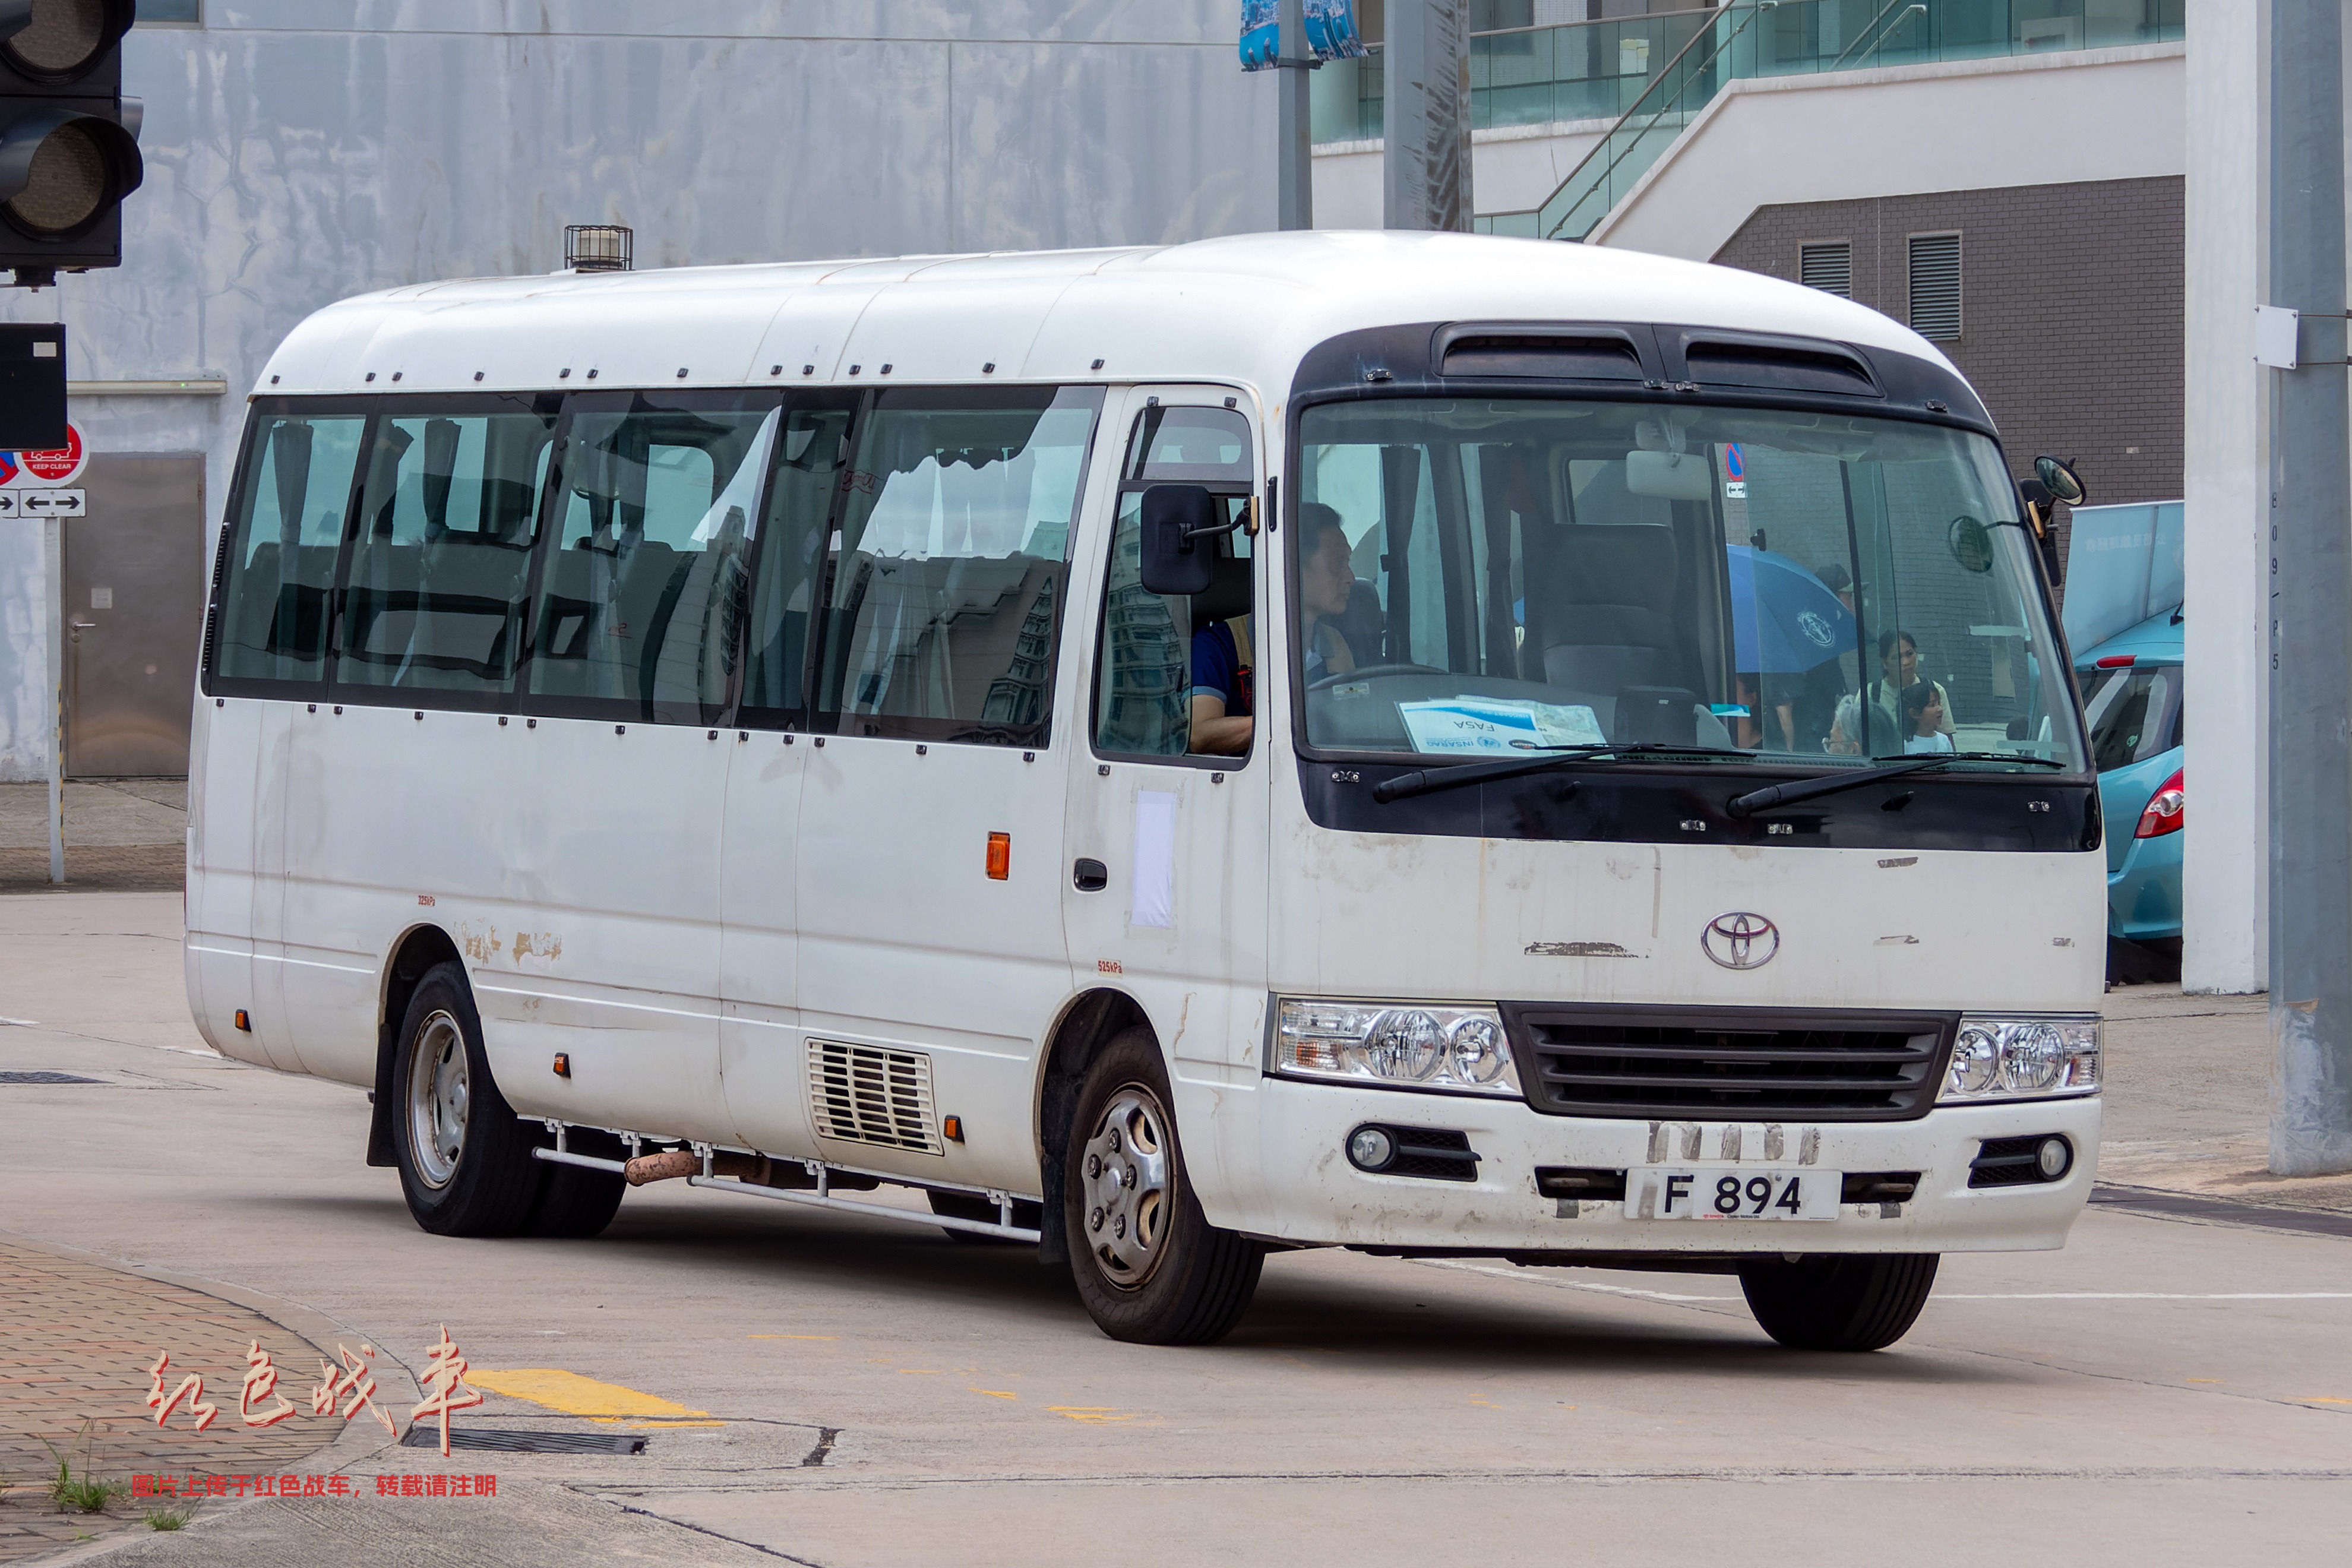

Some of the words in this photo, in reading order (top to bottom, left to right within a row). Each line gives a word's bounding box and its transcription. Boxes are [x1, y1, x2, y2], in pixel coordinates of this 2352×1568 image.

[1454, 720, 1495, 732] FASA
[1098, 960, 1123, 973] 525kPa
[1664, 1175, 1695, 1213] F
[1714, 1176, 1801, 1215] 894
